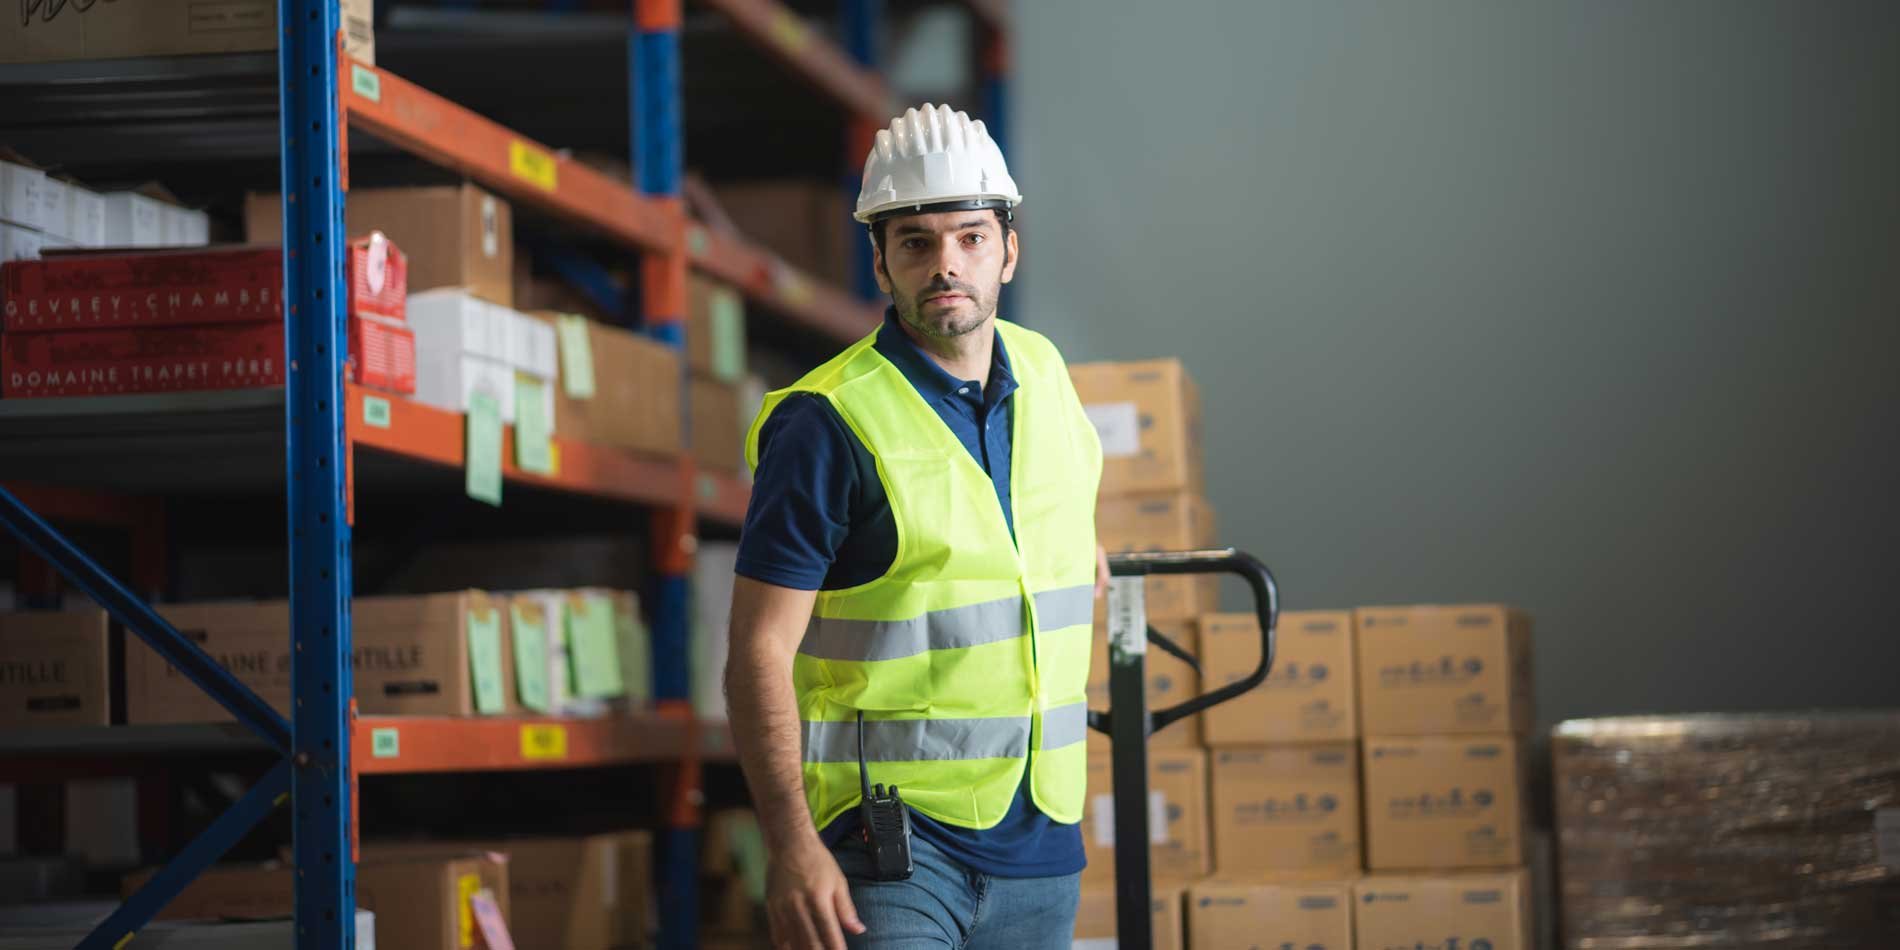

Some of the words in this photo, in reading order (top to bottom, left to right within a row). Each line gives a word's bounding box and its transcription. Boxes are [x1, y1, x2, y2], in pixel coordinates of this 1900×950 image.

[5, 288, 285, 316] GEVREY-CHAMBE
[11, 367, 118, 388] DOMAINE
[131, 361, 209, 382] TRAPET
[222, 357, 273, 377] PÈRE
